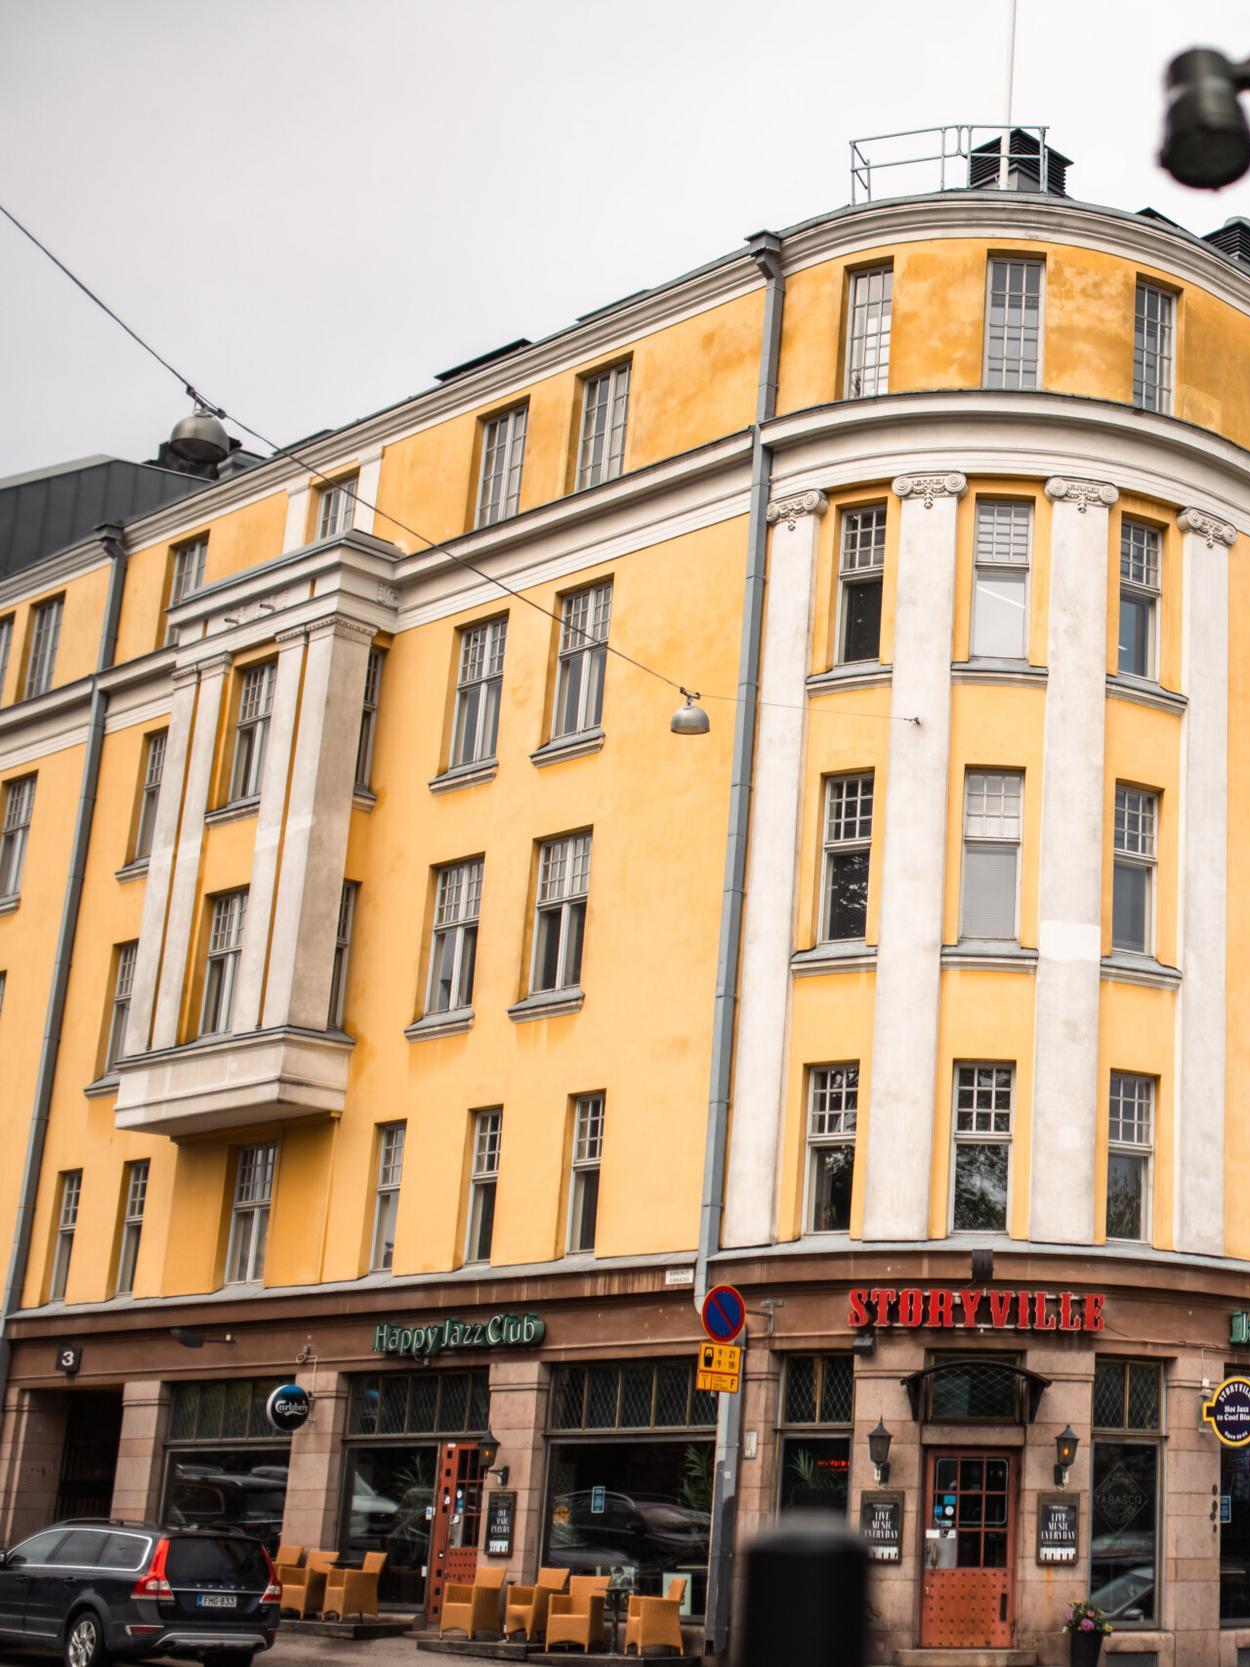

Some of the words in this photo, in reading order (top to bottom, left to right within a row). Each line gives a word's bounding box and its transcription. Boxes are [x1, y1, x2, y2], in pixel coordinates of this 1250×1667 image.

[848, 1288, 1105, 1331] STORYVILLE
[373, 1322, 439, 1356] Happy
[441, 1317, 483, 1347] Jazz
[485, 1313, 544, 1345] Club
[62, 1351, 74, 1366] 3
[1224, 1405, 1237, 1413] Hot
[1237, 1405, 1249, 1413] Jazz
[875, 1512, 889, 1521] LIVE
[1051, 1513, 1066, 1521] LIVE
[872, 1521, 892, 1529] MUSIC
[1048, 1522, 1069, 1531] MUSIC
[1041, 1531, 1076, 1540] EVERYDAY
